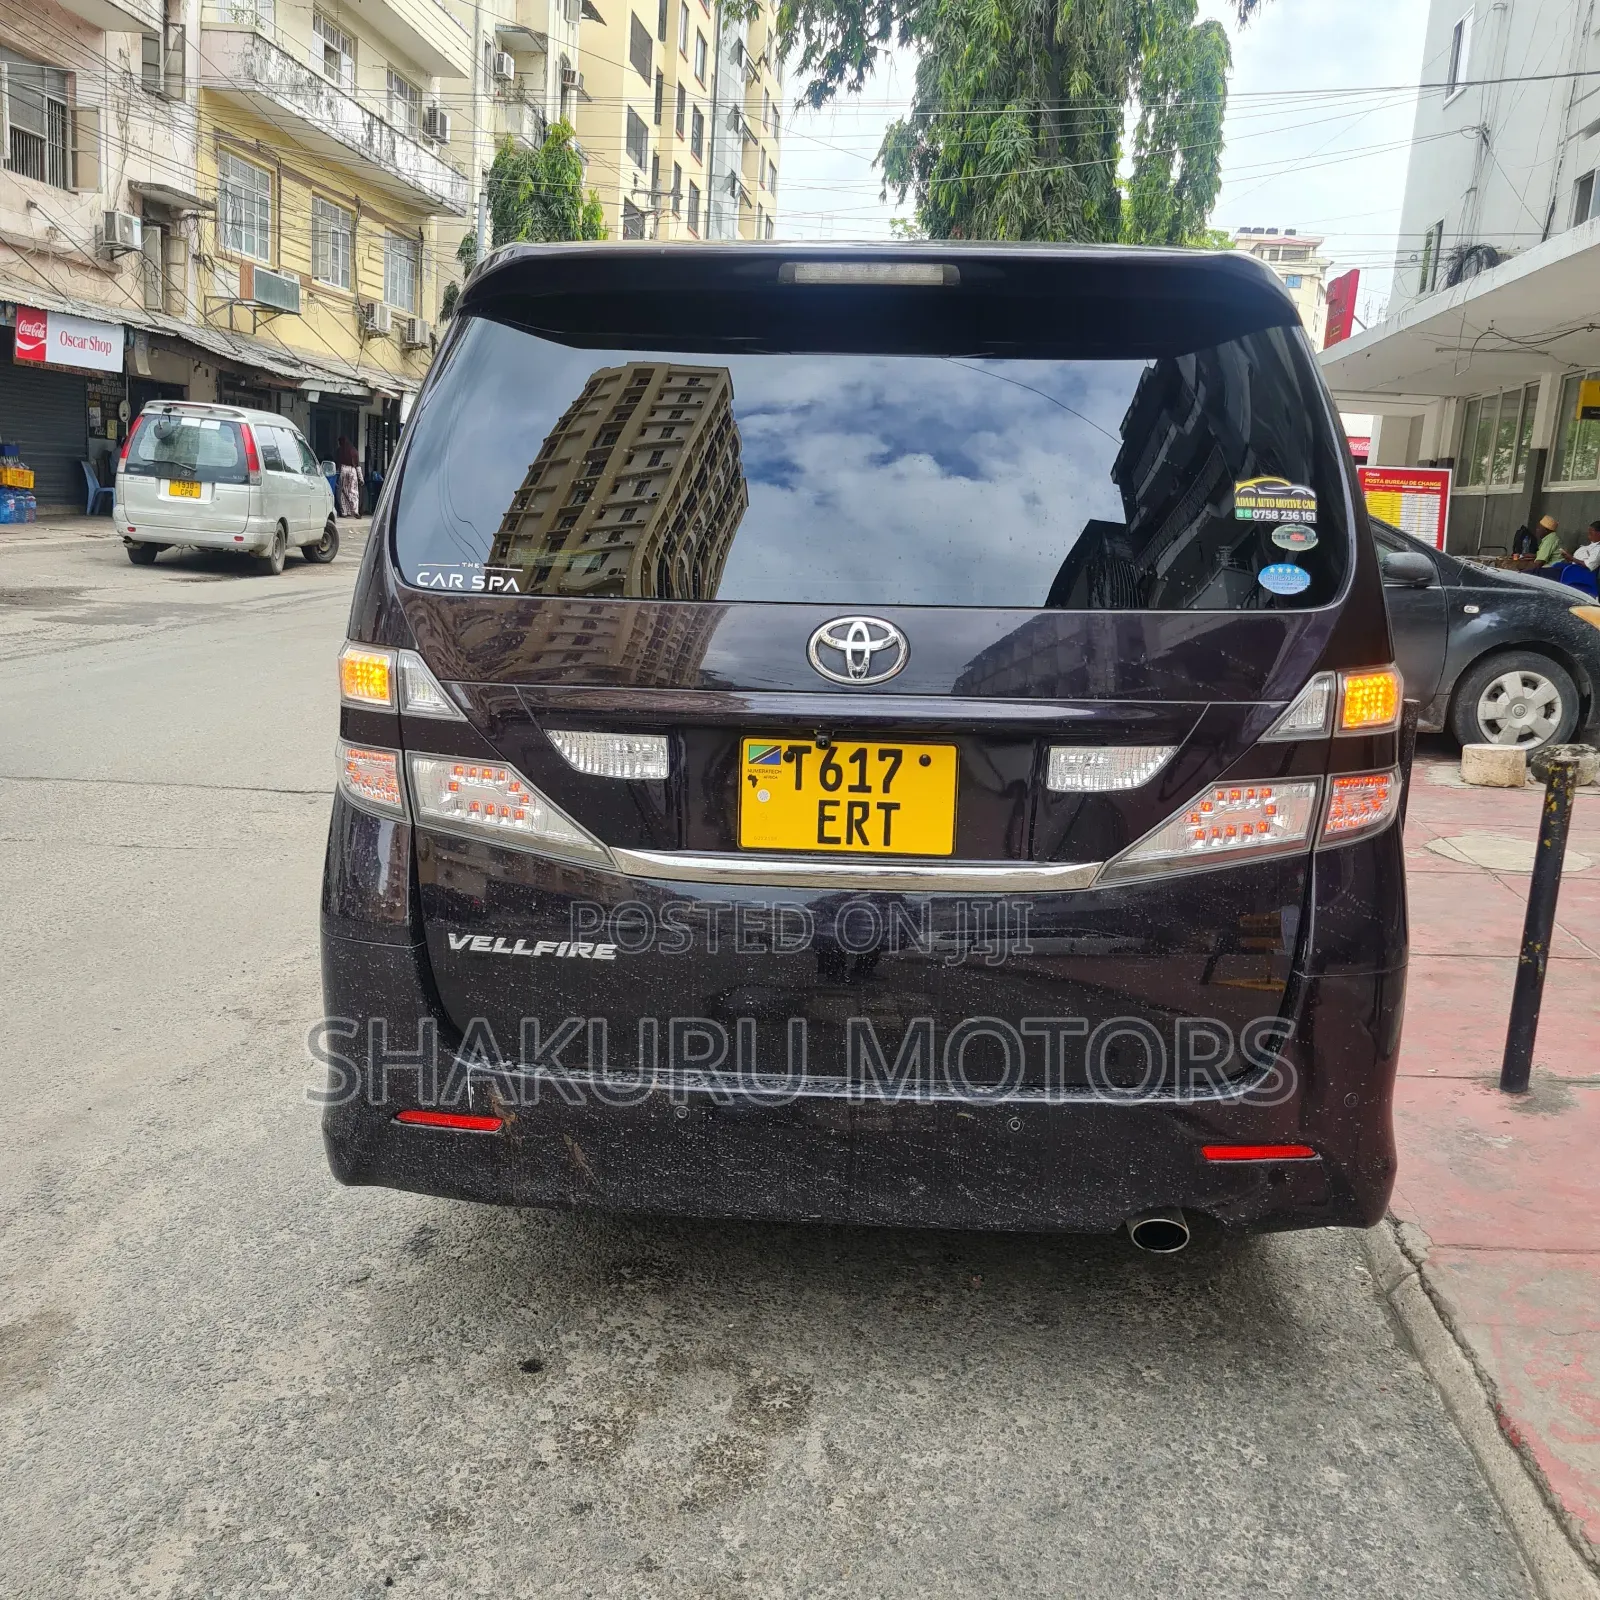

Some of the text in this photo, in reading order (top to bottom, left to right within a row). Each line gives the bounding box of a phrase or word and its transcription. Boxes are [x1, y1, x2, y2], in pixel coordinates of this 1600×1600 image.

[60, 330, 112, 356] Oscar Shop
[1235, 497, 1317, 510] ADAM AUTO MOTIVE CAR
[1252, 509, 1316, 522] 0758 236 161
[416, 571, 520, 593] CAR SPA
[817, 799, 901, 847] ERT
[448, 932, 618, 960] VELLFIRE
